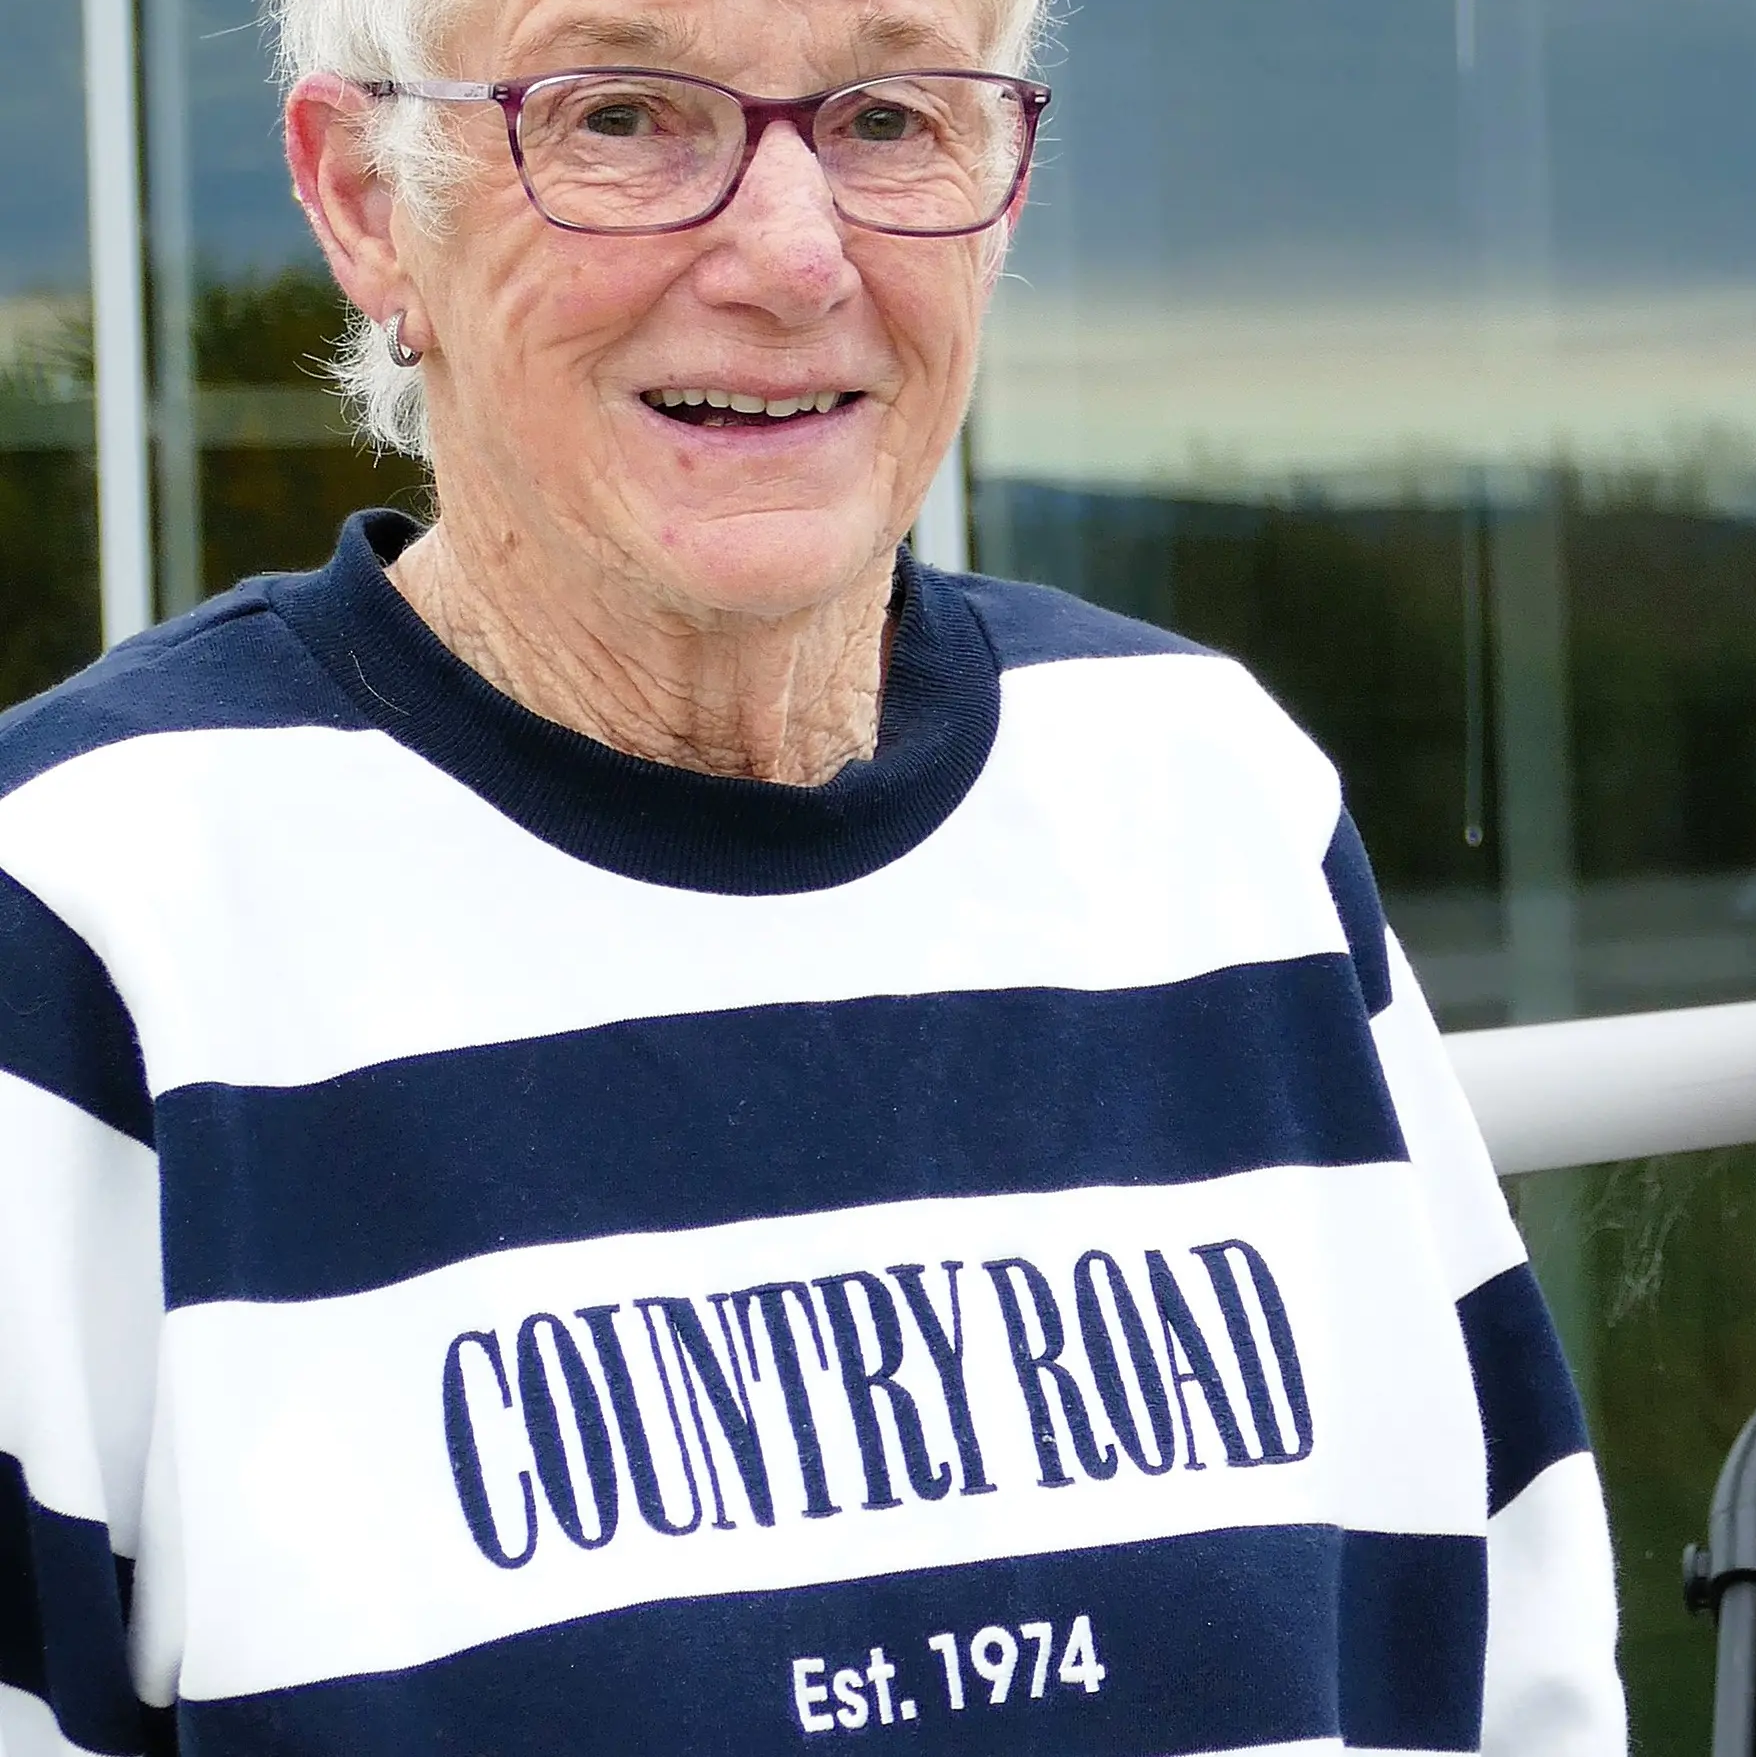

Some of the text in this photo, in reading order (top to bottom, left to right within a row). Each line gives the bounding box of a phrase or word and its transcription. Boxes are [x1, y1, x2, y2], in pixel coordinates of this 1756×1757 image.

[441, 1237, 1315, 1571] COUNTRY ROAD
[789, 1614, 1107, 1735] Est. 1974
